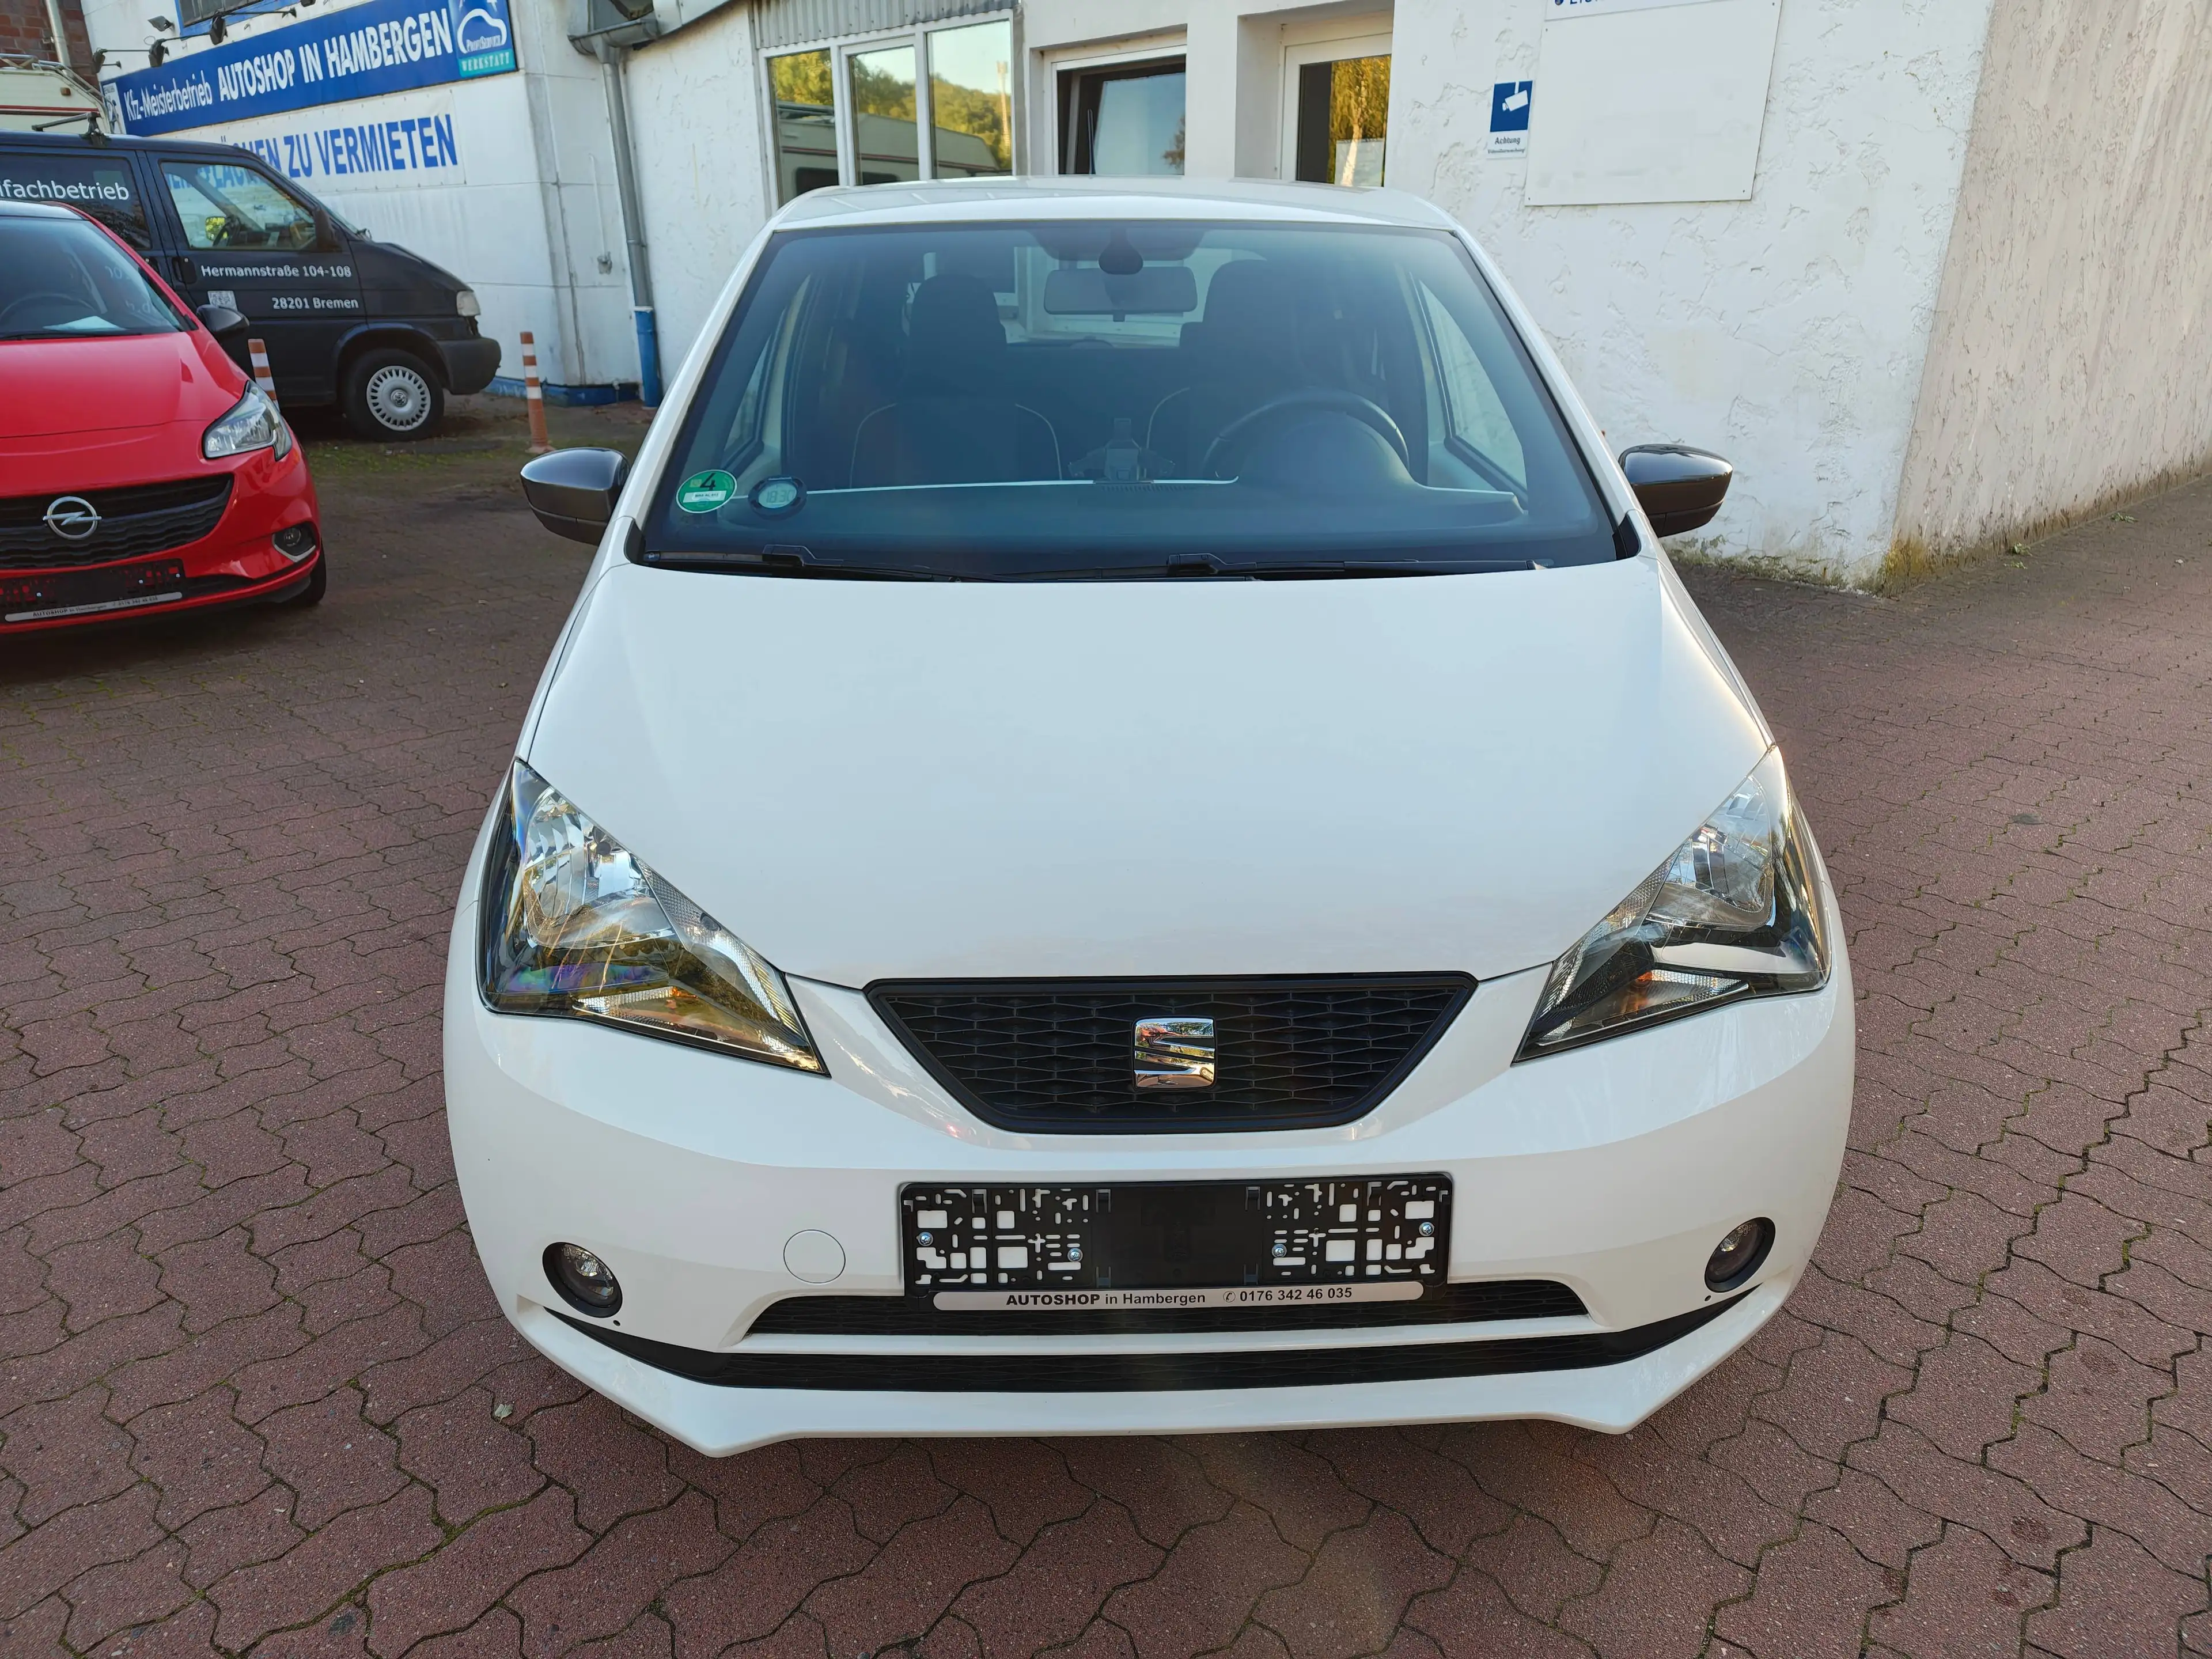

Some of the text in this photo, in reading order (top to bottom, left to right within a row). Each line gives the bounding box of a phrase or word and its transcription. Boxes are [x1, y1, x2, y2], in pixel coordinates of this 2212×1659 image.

[123, 7, 453, 122] Kfz-Meisterbetrieb AUTOSHOP IN HAMBERGEN
[283, 133, 312, 179] ZU
[315, 113, 457, 175] VERMIETEN
[1494, 136, 1521, 145] Achtung
[200, 265, 352, 277] Hermannstraße 104-108
[272, 297, 359, 309] 28201 Bremen
[699, 472, 716, 491] 4
[1006, 1287, 1353, 1306] AUTOSHOP in Hambergen 0176 342 46 035
